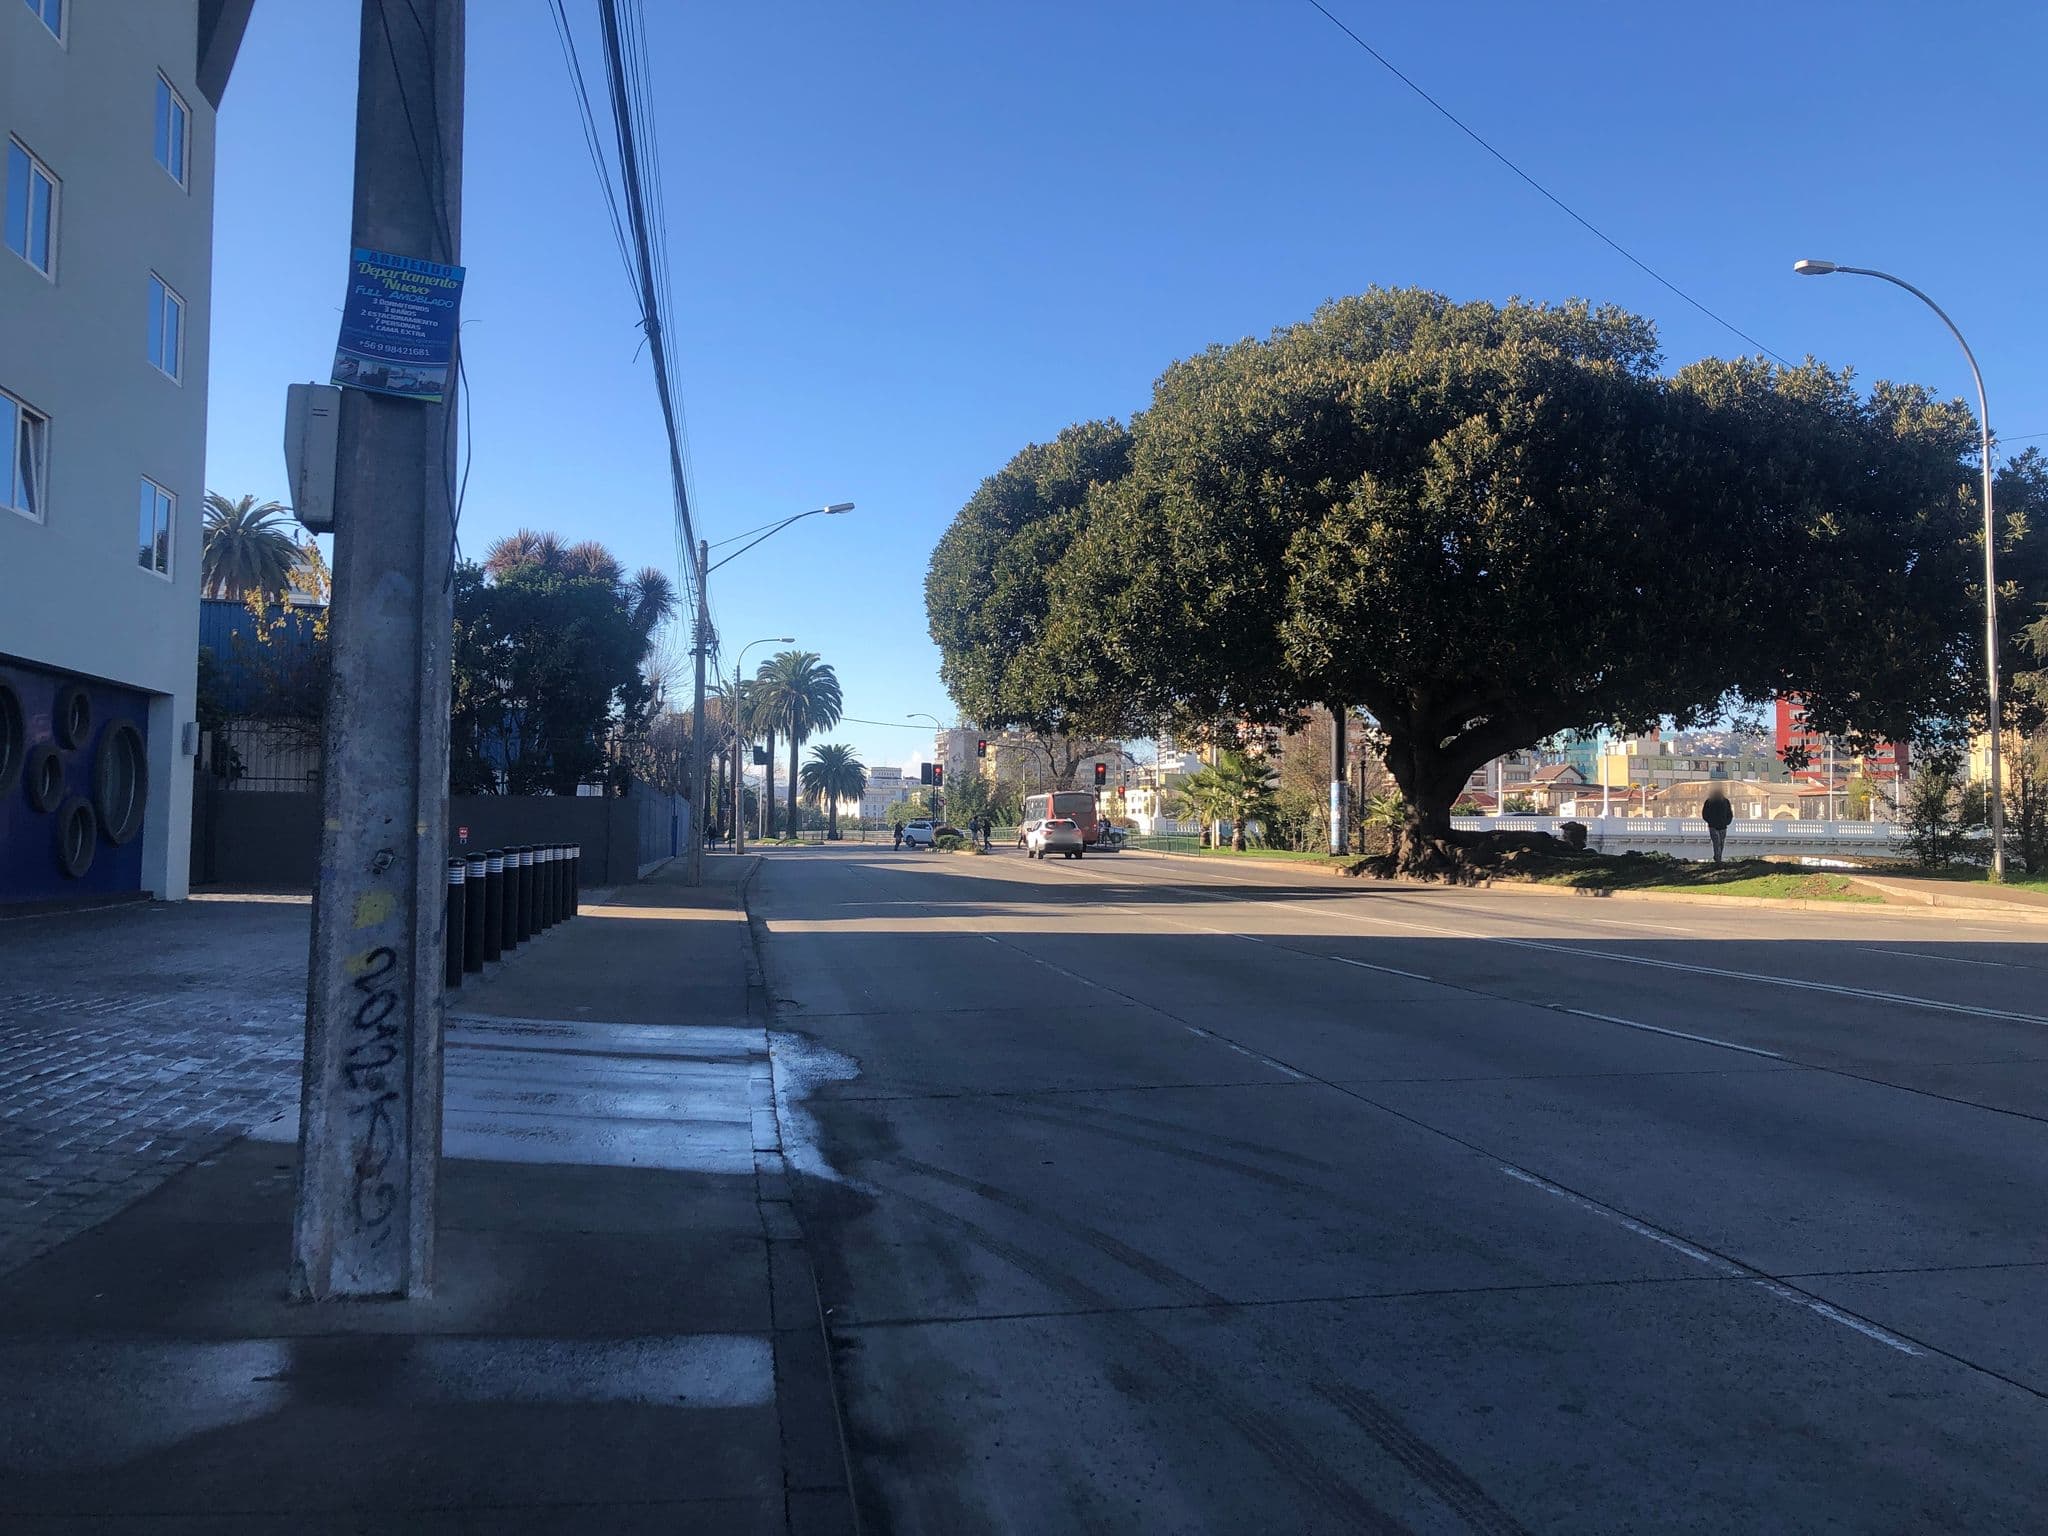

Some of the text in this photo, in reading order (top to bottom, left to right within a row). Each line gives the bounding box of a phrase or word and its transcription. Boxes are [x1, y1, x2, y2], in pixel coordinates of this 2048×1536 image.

[357, 262, 459, 289] Departamento
[382, 277, 431, 295] Nuevo
[355, 285, 455, 309] FULL AMOBLADO
[379, 299, 430, 313] DORMITORIOS
[360, 309, 439, 327] 2 ESTACIONAMIENTO
[380, 319, 422, 331] PERSONAS
[376, 325, 400, 334] CAMA
[400, 328, 426, 338] EXTRA
